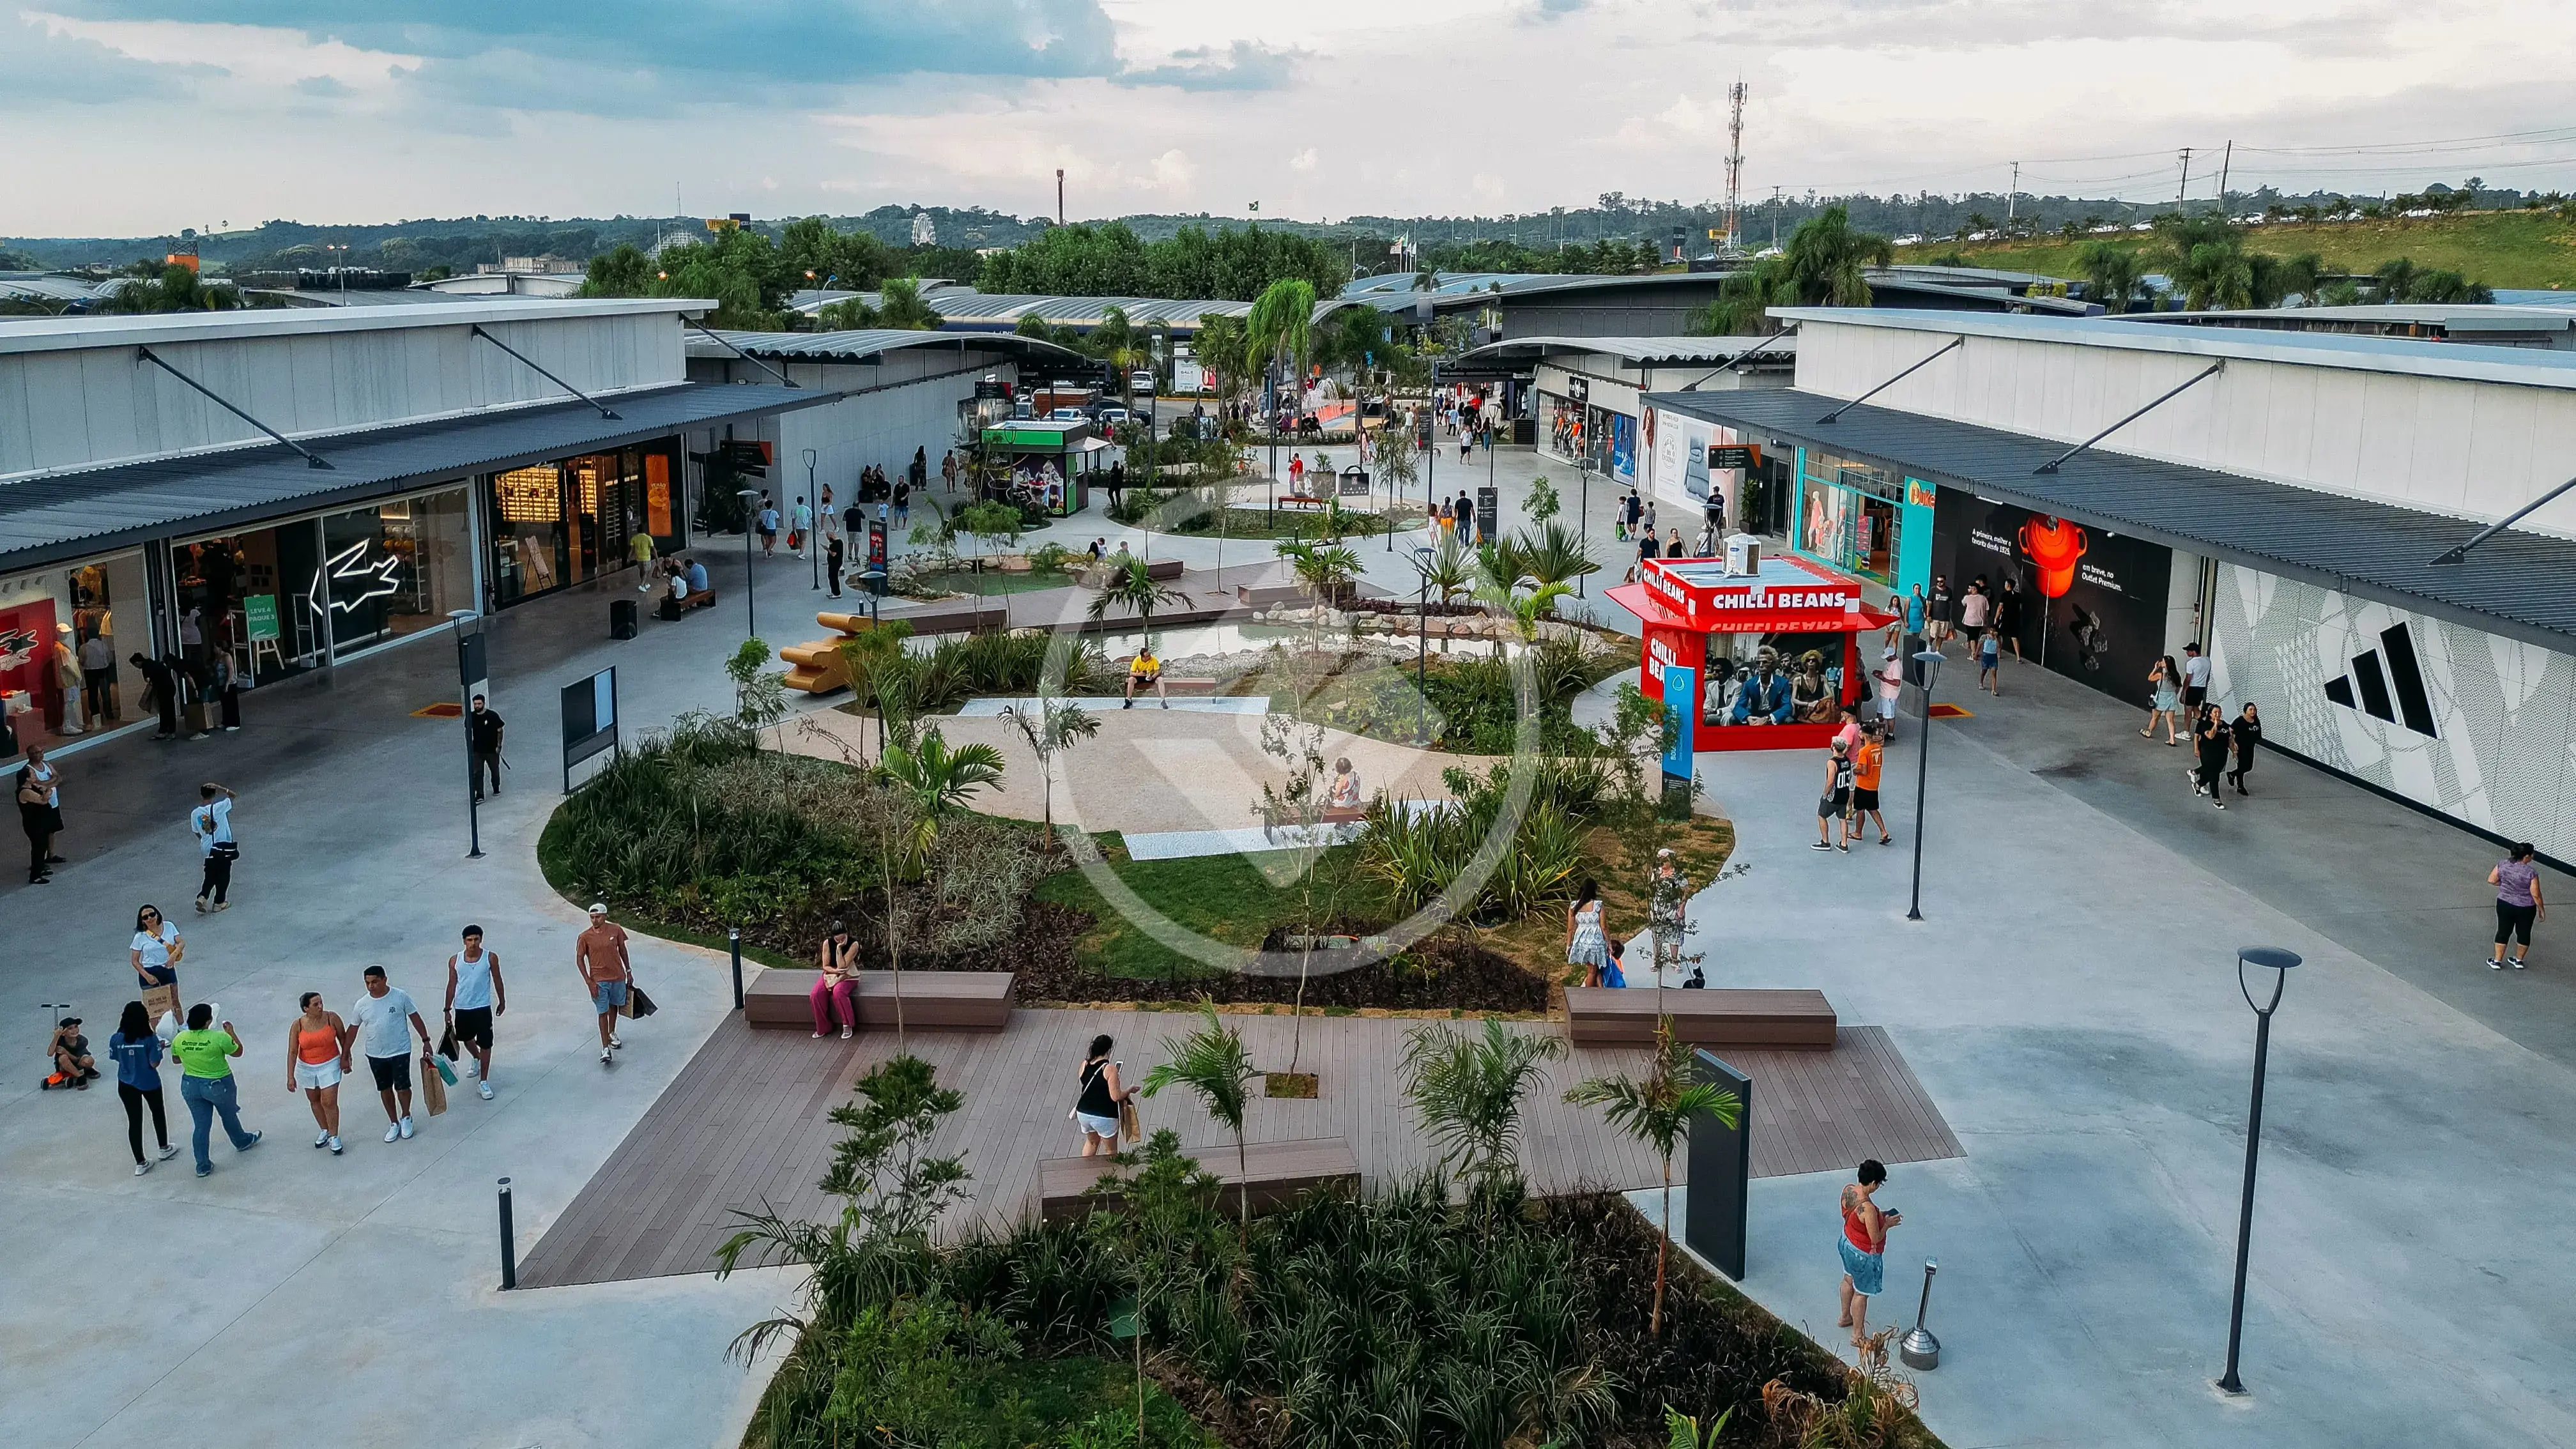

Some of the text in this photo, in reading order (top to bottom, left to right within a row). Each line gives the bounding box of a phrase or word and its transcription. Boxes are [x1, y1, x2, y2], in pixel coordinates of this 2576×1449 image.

[2091, 565, 2106, 577] breve,
[1643, 568, 1685, 604] CHILLI BEANS
[2082, 572, 2122, 592] Outlet Premium.
[1713, 592, 1846, 609] CHILLI BEANS
[1650, 638, 1676, 666] CHILLI
